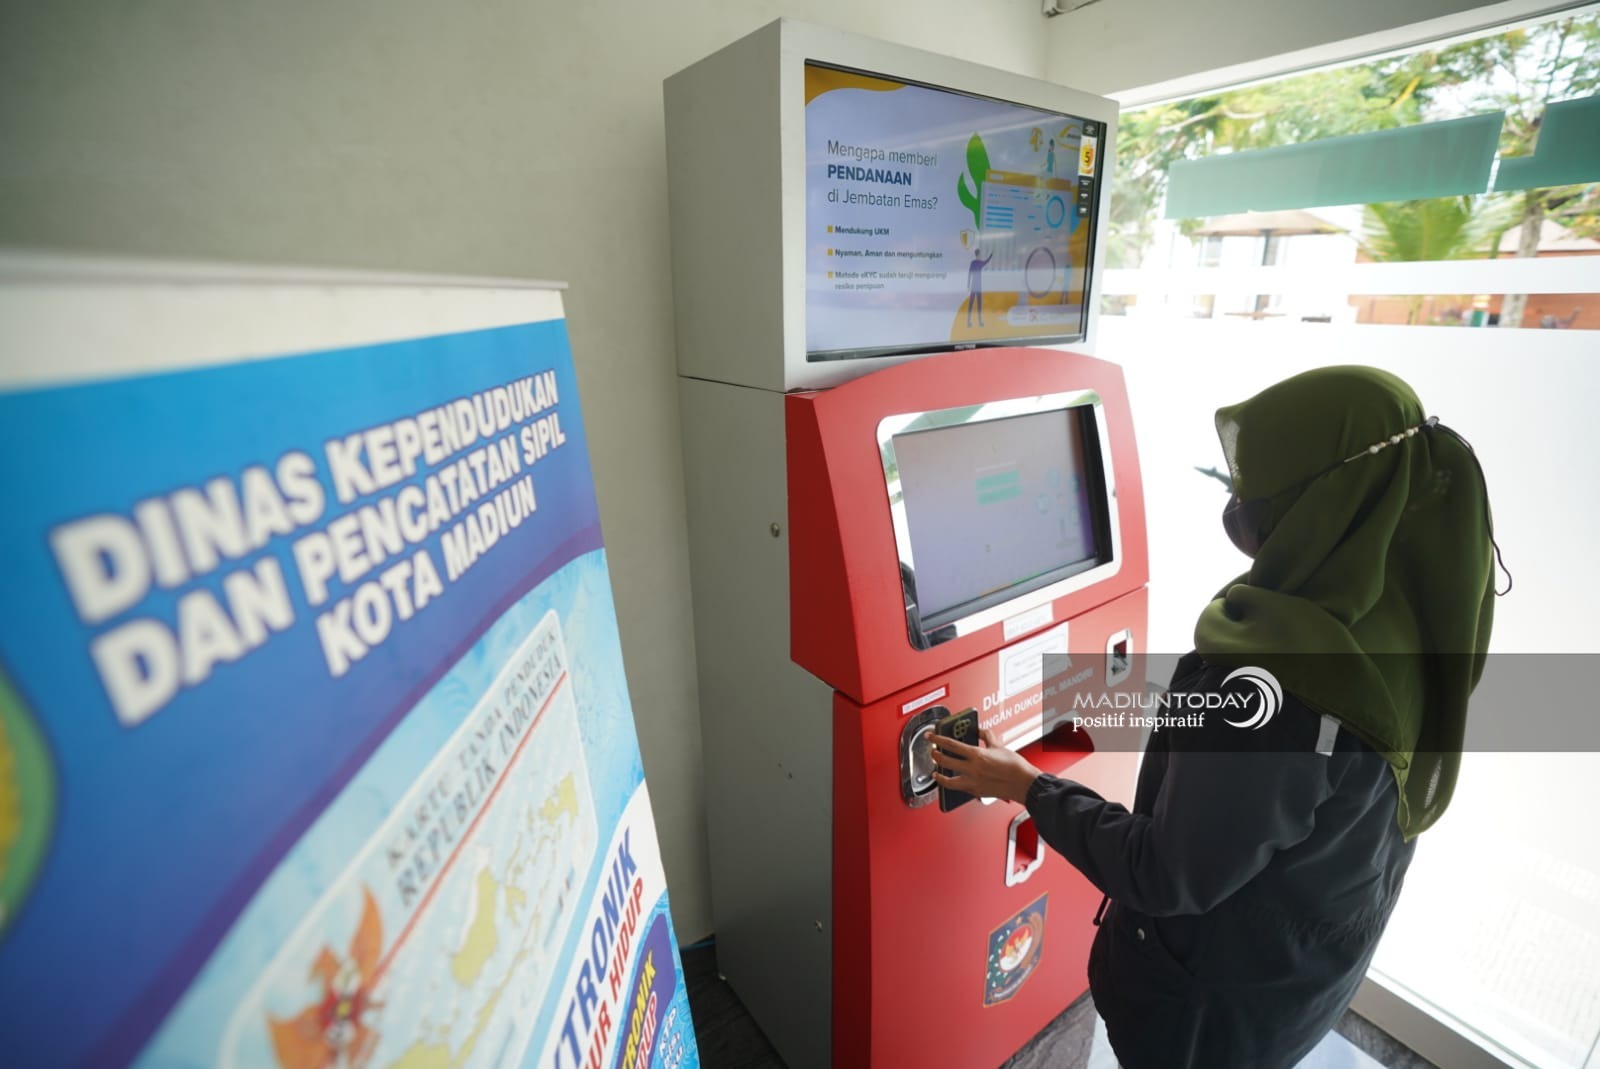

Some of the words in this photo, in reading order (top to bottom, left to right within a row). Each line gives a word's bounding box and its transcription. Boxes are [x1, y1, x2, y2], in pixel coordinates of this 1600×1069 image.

[827, 188, 839, 204] di
[843, 189, 901, 207] Jembatan
[904, 194, 938, 210] Emas?
[828, 139, 885, 163] Mengapa
[889, 151, 938, 167] memberi
[828, 164, 912, 186] PENDANAAN
[835, 225, 873, 237] Mendukung
[874, 227, 890, 236] UKM
[51, 450, 326, 626] DINAS
[325, 369, 560, 502] KEPENDUDUKAN
[90, 556, 296, 728] DAN
[293, 437, 522, 606] PENCATATAN
[520, 412, 566, 465] SIPIL
[316, 550, 443, 678] KOTA
[440, 475, 537, 582] MADIUN
[397, 760, 496, 908] REPUBLIK
[499, 654, 563, 755] INDONESIA
[609, 877, 643, 1004] HIDUP
